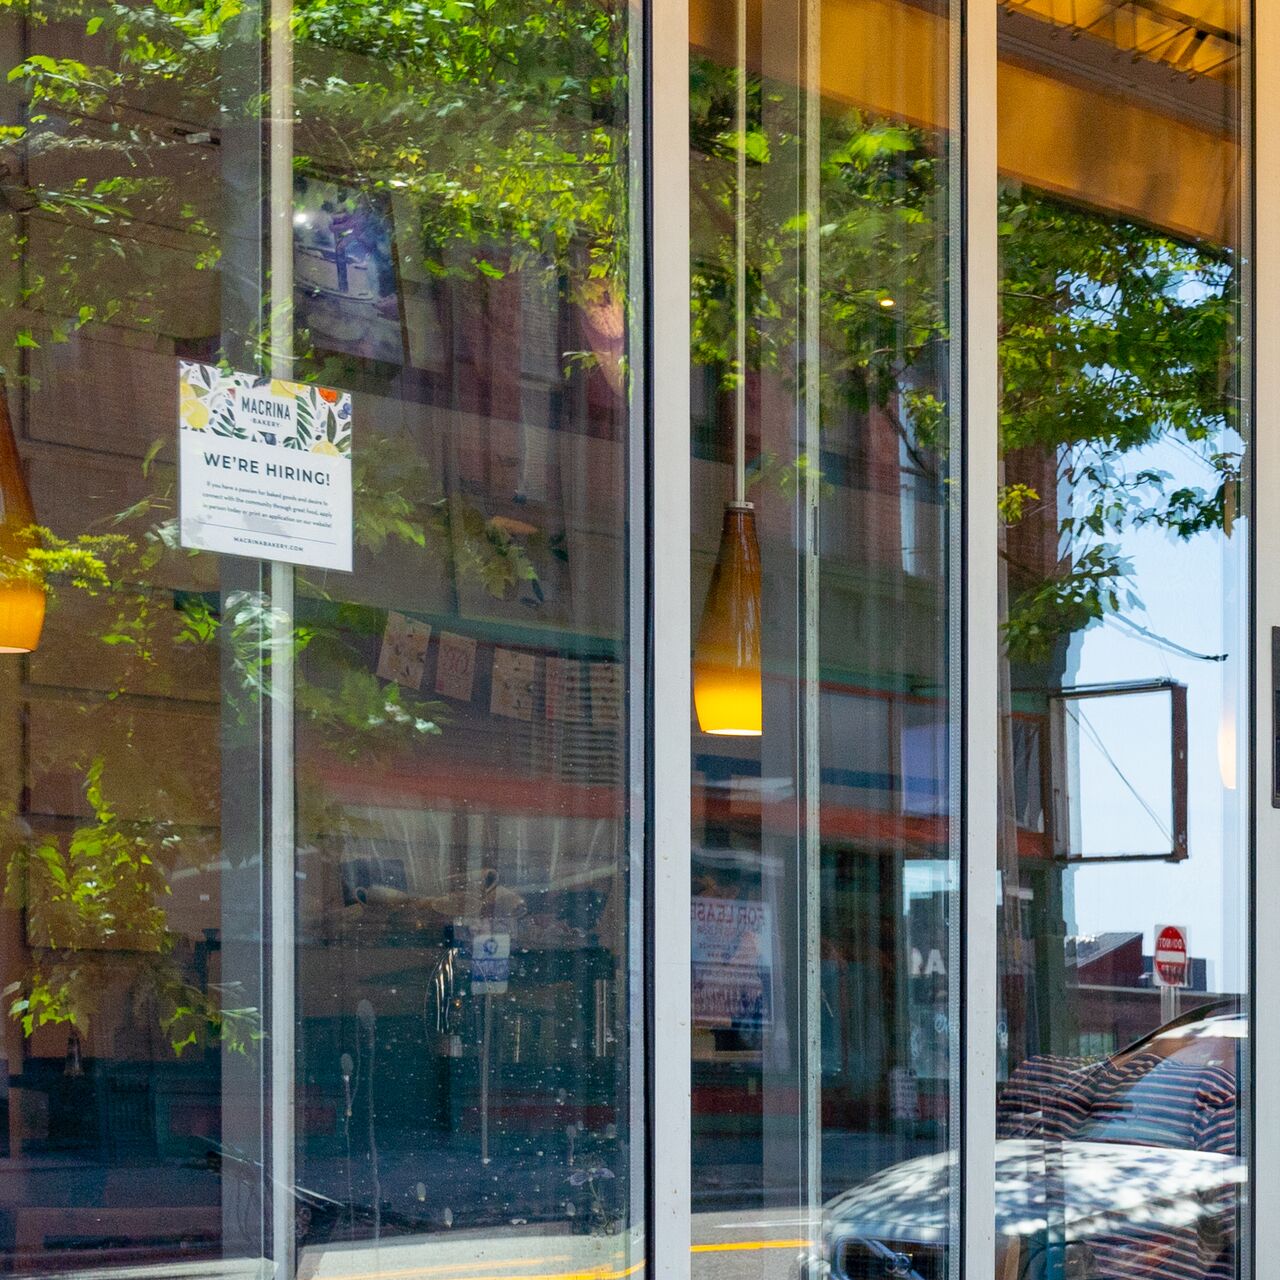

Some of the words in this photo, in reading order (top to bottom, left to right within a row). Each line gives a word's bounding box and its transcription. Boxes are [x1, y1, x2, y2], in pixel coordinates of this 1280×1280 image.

[241, 396, 291, 420] MACRINA
[252, 418, 280, 428] BAKERY
[204, 452, 259, 474] WE'RE
[266, 463, 330, 486] HIRING!
